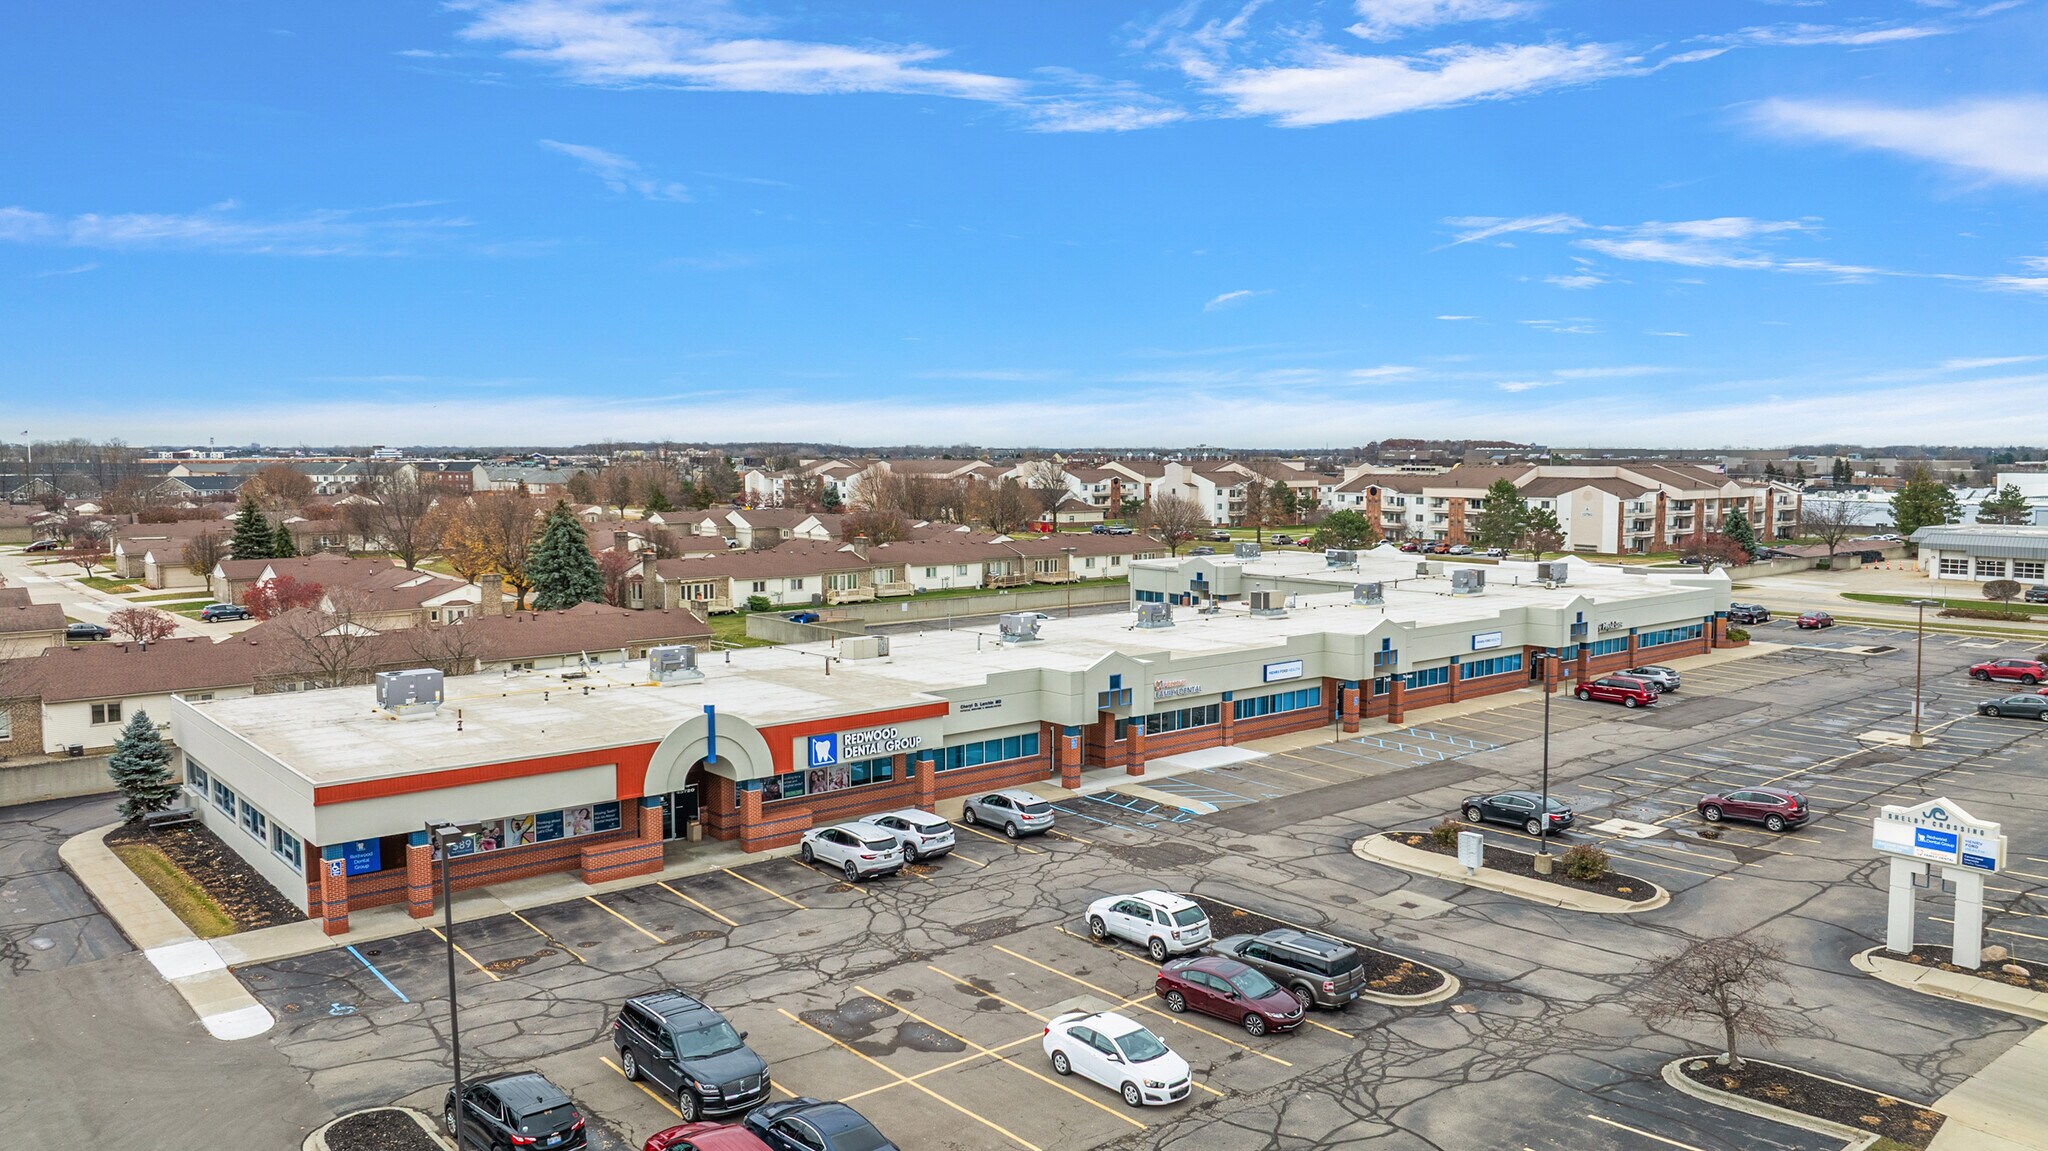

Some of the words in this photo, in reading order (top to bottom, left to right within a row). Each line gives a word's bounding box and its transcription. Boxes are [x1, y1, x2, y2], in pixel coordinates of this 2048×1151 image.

[1178, 685, 1202, 696] DENTAL
[843, 727, 898, 746] REDWOOD
[843, 743, 882, 759] DENTAL
[885, 736, 922, 752] GROUP
[1888, 813, 1925, 825] SHELBY
[1932, 821, 1985, 836] CROSSING
[1926, 834, 1948, 842] Redwood
[349, 851, 374, 859] Redwood
[353, 857, 370, 865] Dental
